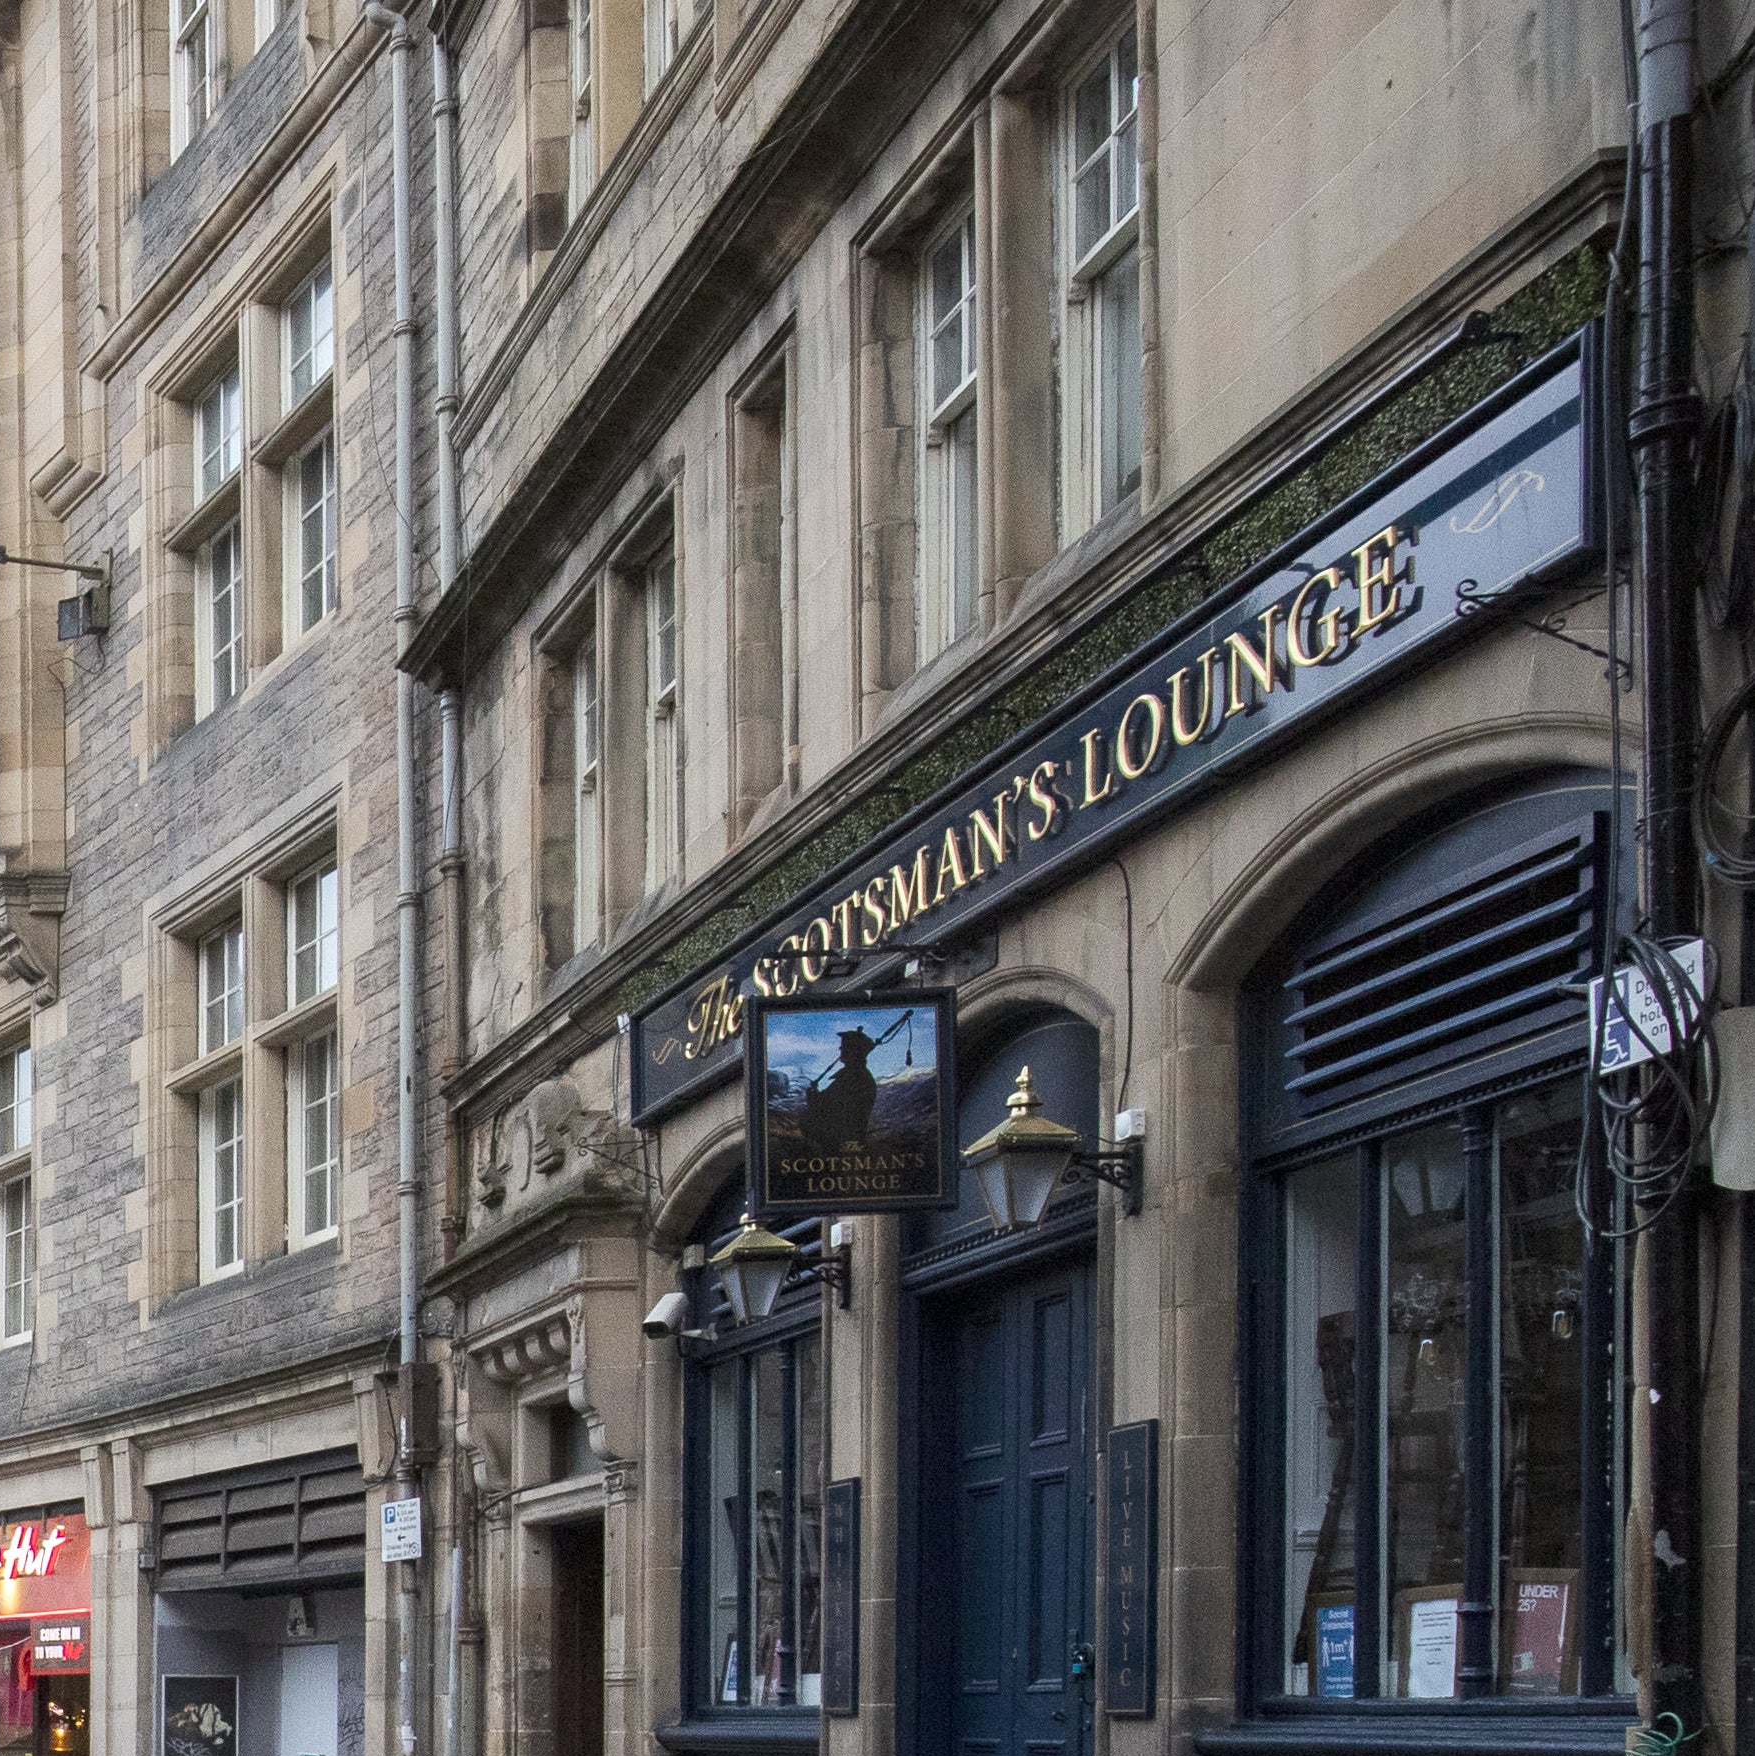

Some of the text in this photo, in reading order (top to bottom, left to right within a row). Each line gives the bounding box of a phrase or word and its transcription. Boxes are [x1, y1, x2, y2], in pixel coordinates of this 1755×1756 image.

[686, 524, 1413, 1060] The SCOTSMAN'S LOUNGE
[780, 1153, 926, 1174] SCOTSMAN'S
[807, 1174, 902, 1193] LOUNGE
[2, 1524, 68, 1581] Hut
[1120, 1451, 1134, 1688] LIVE MUSIC
[1518, 1584, 1559, 1599] UNDER
[1517, 1600, 1537, 1613] 25?
[40, 1626, 61, 1642] COME
[45, 1645, 64, 1660] YOUR
